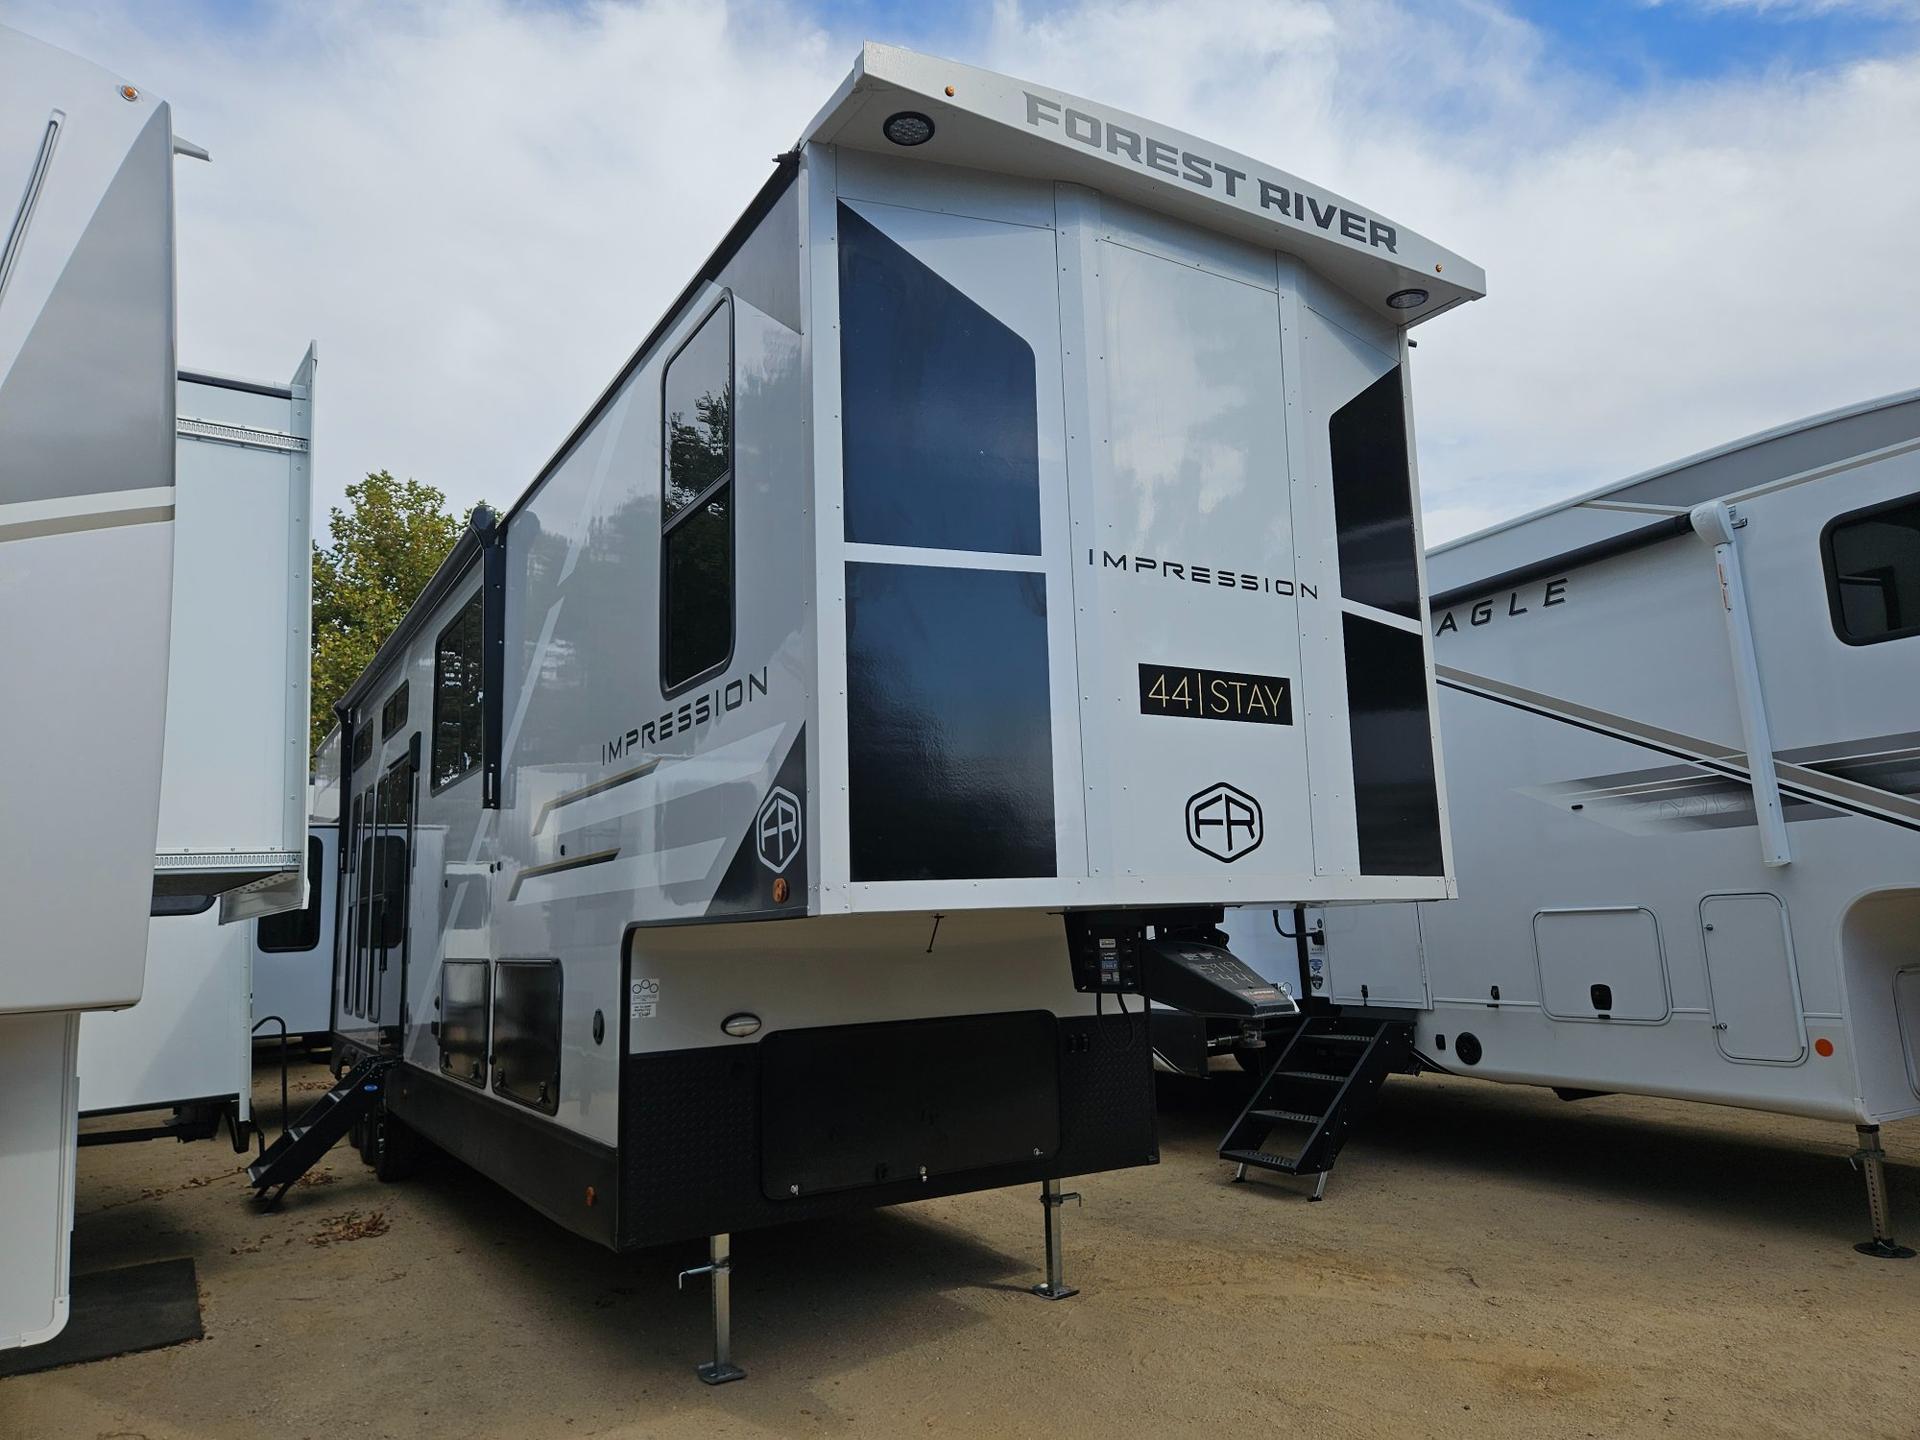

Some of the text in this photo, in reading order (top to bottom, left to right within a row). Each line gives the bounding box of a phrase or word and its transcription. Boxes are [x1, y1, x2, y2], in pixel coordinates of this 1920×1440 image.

[1022, 91, 1398, 254] FOREST RIVER
[1088, 548, 1318, 600] IMPRESSION
[602, 666, 767, 766] IMPRESSION
